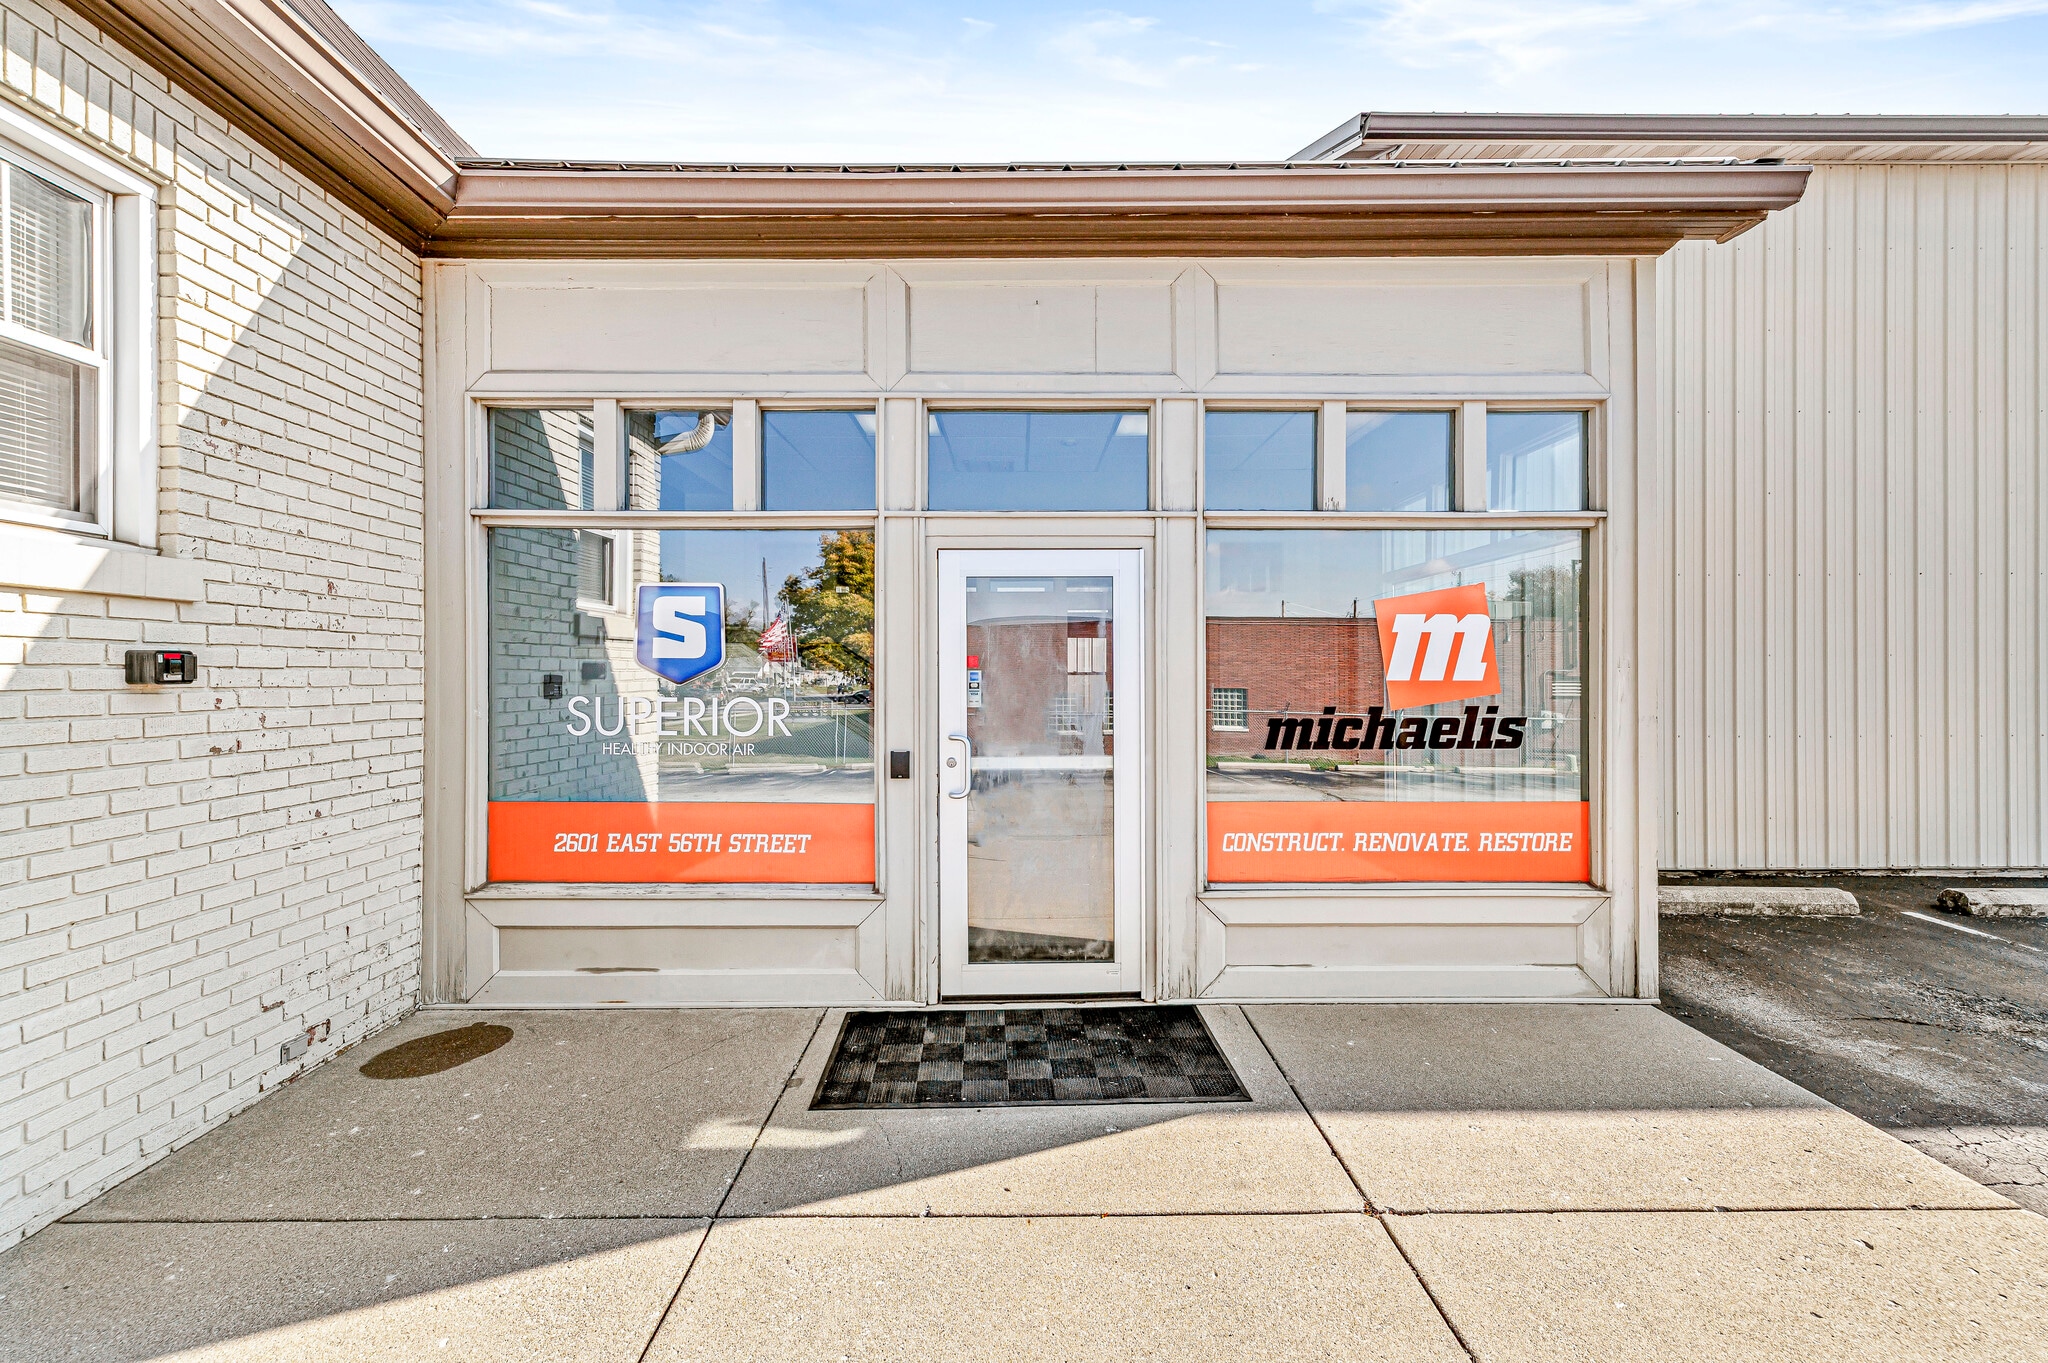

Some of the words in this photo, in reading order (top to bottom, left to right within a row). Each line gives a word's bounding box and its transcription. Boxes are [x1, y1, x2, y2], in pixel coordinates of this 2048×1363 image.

[652, 595, 707, 659] S
[1387, 612, 1491, 682] m
[566, 695, 792, 737] SUPERIOR
[1264, 706, 1528, 750] michaelis
[602, 742, 662, 756] HEALTHY
[667, 742, 728, 756] INDOOR
[732, 742, 755, 756] AIR
[553, 833, 598, 853] 2601
[606, 833, 662, 853] EAST
[668, 833, 722, 853] 56TH
[728, 833, 812, 854] STREET
[1222, 832, 1345, 852] CONSTRUCT.
[1353, 832, 1470, 852] RENOVATE.
[1477, 832, 1573, 852] RESTORE
